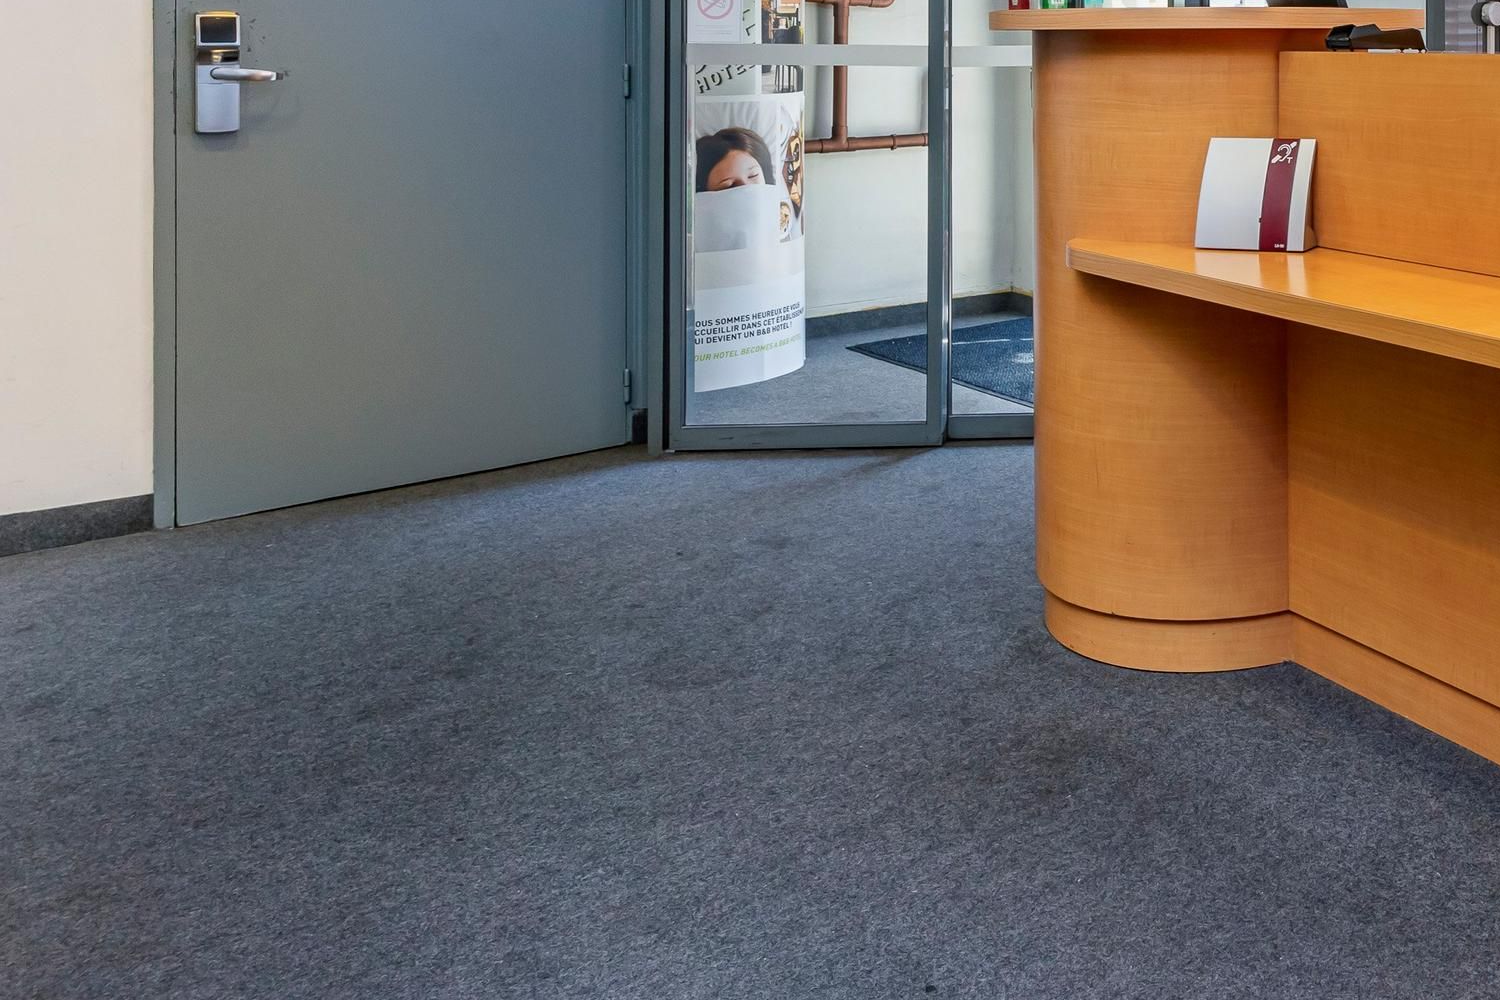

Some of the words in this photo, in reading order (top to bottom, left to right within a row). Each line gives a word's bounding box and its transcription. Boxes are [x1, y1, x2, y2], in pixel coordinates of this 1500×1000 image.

[715, 314, 750, 326] SOMMES
[752, 307, 783, 320] HEUREUX
[782, 305, 790, 313] DE
[741, 320, 762, 331] DANS
[763, 317, 775, 327] CET
[706, 332, 742, 344] DEVIENT
[743, 330, 755, 339] UN
[756, 327, 772, 337] B&B
[772, 323, 789, 334] HOTEL
[713, 350, 738, 360] HOTEL
